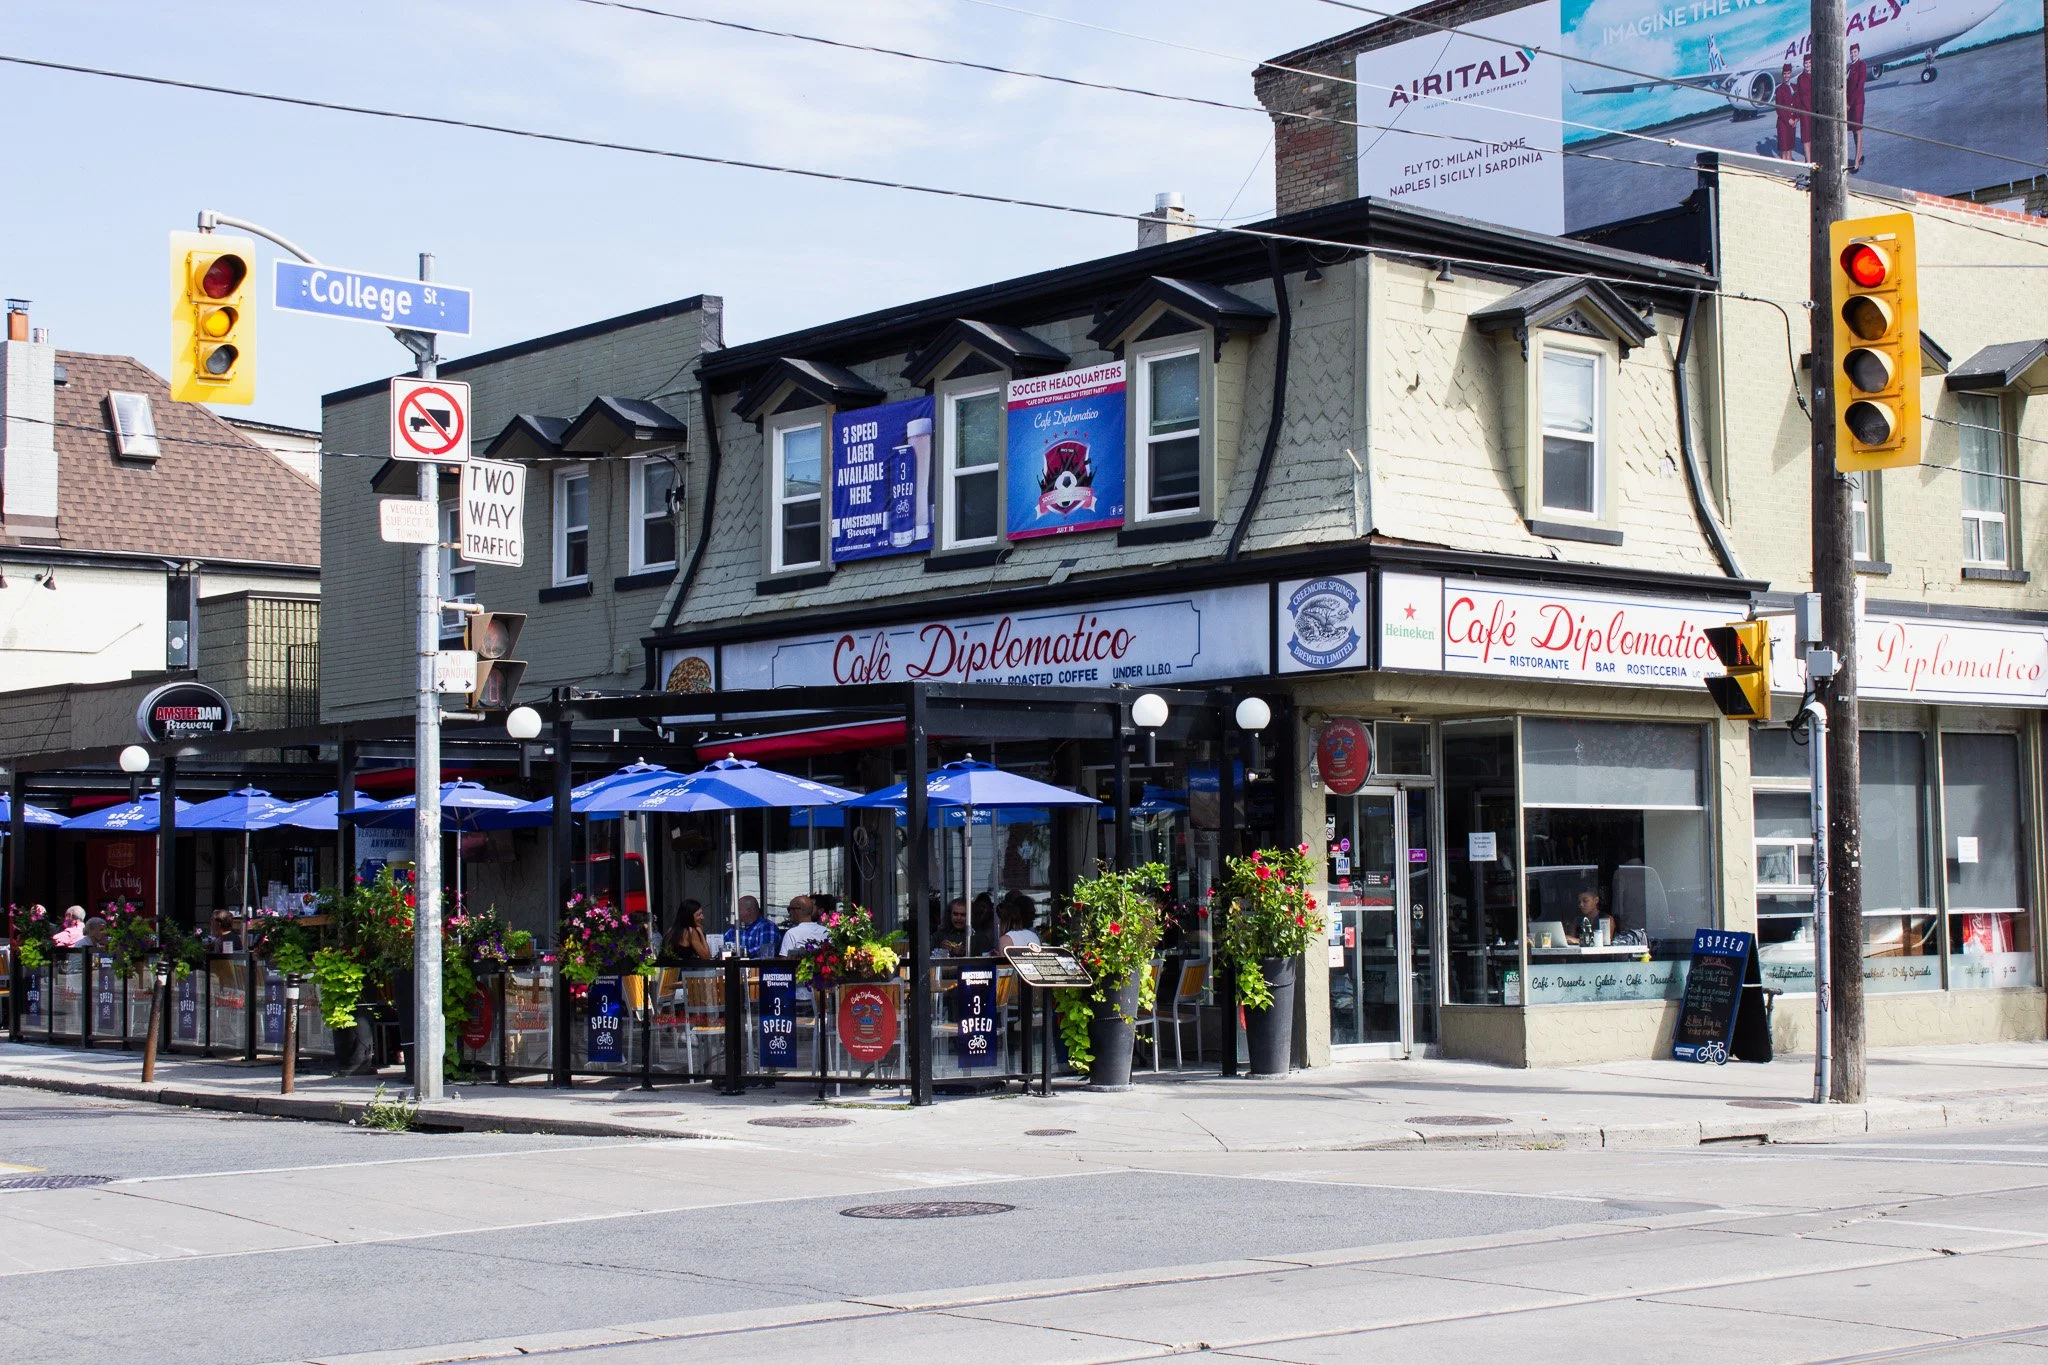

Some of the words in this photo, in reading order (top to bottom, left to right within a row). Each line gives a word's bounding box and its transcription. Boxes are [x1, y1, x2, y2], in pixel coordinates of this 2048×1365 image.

[1602, 12, 1687, 45] IMAGINE
[1690, 0, 1731, 22] THE
[1388, 46, 1541, 108] AIRITALY
[1463, 90, 1485, 100] WORLD
[1486, 79, 1527, 94] DIFFERENTLY
[1404, 162, 1427, 177] FLY
[1426, 158, 1444, 172] TO:
[1447, 148, 1483, 167] MILAN
[1492, 137, 1526, 156] ROME
[1390, 178, 1431, 197] NAPLES
[1440, 167, 1475, 186] SICILY
[1485, 152, 1543, 174] SARDINIA
[310, 271, 412, 321] College
[424, 288, 437, 305] St
[1012, 381, 1047, 397] SOCCER
[1049, 366, 1121, 390] HEADQUARTERS
[1034, 411, 1051, 431] Café
[1053, 407, 1099, 428] Diplomatico
[843, 427, 849, 445] 3
[851, 422, 878, 444] SPEED
[847, 443, 875, 465] LAGER
[470, 466, 515, 496] TWO
[838, 462, 884, 487] AVAILABLE
[900, 462, 906, 481] 3
[849, 485, 872, 505] HERE
[892, 482, 914, 499] SPEED
[389, 504, 430, 516] VEHICLES
[469, 500, 516, 530] WAY
[385, 516, 422, 528] SUBJECT
[841, 512, 883, 530] AMSTERDAM
[847, 527, 877, 539] Brewery
[467, 534, 518, 557] TRAFFIC
[1292, 580, 1328, 606] CREEMORE
[1327, 580, 1355, 602] SPRINGS
[1385, 623, 1435, 641] Heineken
[1447, 596, 1517, 664] Café
[1531, 603, 1718, 671] Diplomatico
[906, 615, 1136, 682] Diplomatico
[1293, 646, 1326, 665] BREWERY
[1326, 641, 1354, 664] LIMITED
[1873, 622, 2040, 692] Diplomatico
[450, 654, 461, 666] NO
[1509, 655, 1570, 671] RISTORANTE
[1595, 661, 1616, 674] BAR
[1626, 663, 1688, 677] ROSTICCERIA
[1008, 672, 1053, 685] ROASTED
[1058, 668, 1098, 684] COFFEE
[1112, 665, 1143, 679] UNDER
[156, 706, 221, 720] AMSTERDAM
[164, 719, 214, 731] Brewery
[1337, 861, 1349, 869] ATM
[101, 868, 142, 895] Catering
[1698, 937, 1704, 949] 3
[1707, 935, 1744, 952] SPEED
[763, 973, 792, 981] AMSTERDAM
[961, 971, 993, 980] AMSTERDAM
[1506, 973, 1520, 983] PASS
[1532, 976, 1549, 991] Café
[1557, 976, 1586, 989] Desserts
[1595, 974, 1617, 991] Gelato
[1625, 974, 1642, 987] Café
[1650, 973, 1677, 986] Desserts
[1909, 965, 1932, 980] Specials
[104, 975, 109, 990] 3
[185, 982, 190, 998] 3
[100, 992, 113, 1004] SPEED
[271, 984, 277, 1001] 3
[180, 1000, 195, 1012] SPEED
[266, 1003, 282, 1016] SPEED
[601, 994, 608, 1013] 3
[774, 997, 781, 1016] 3
[973, 995, 981, 1015] 3
[591, 1015, 618, 1030] SPEED
[763, 1019, 792, 1034] SPEED
[961, 1017, 993, 1034] SPEED
